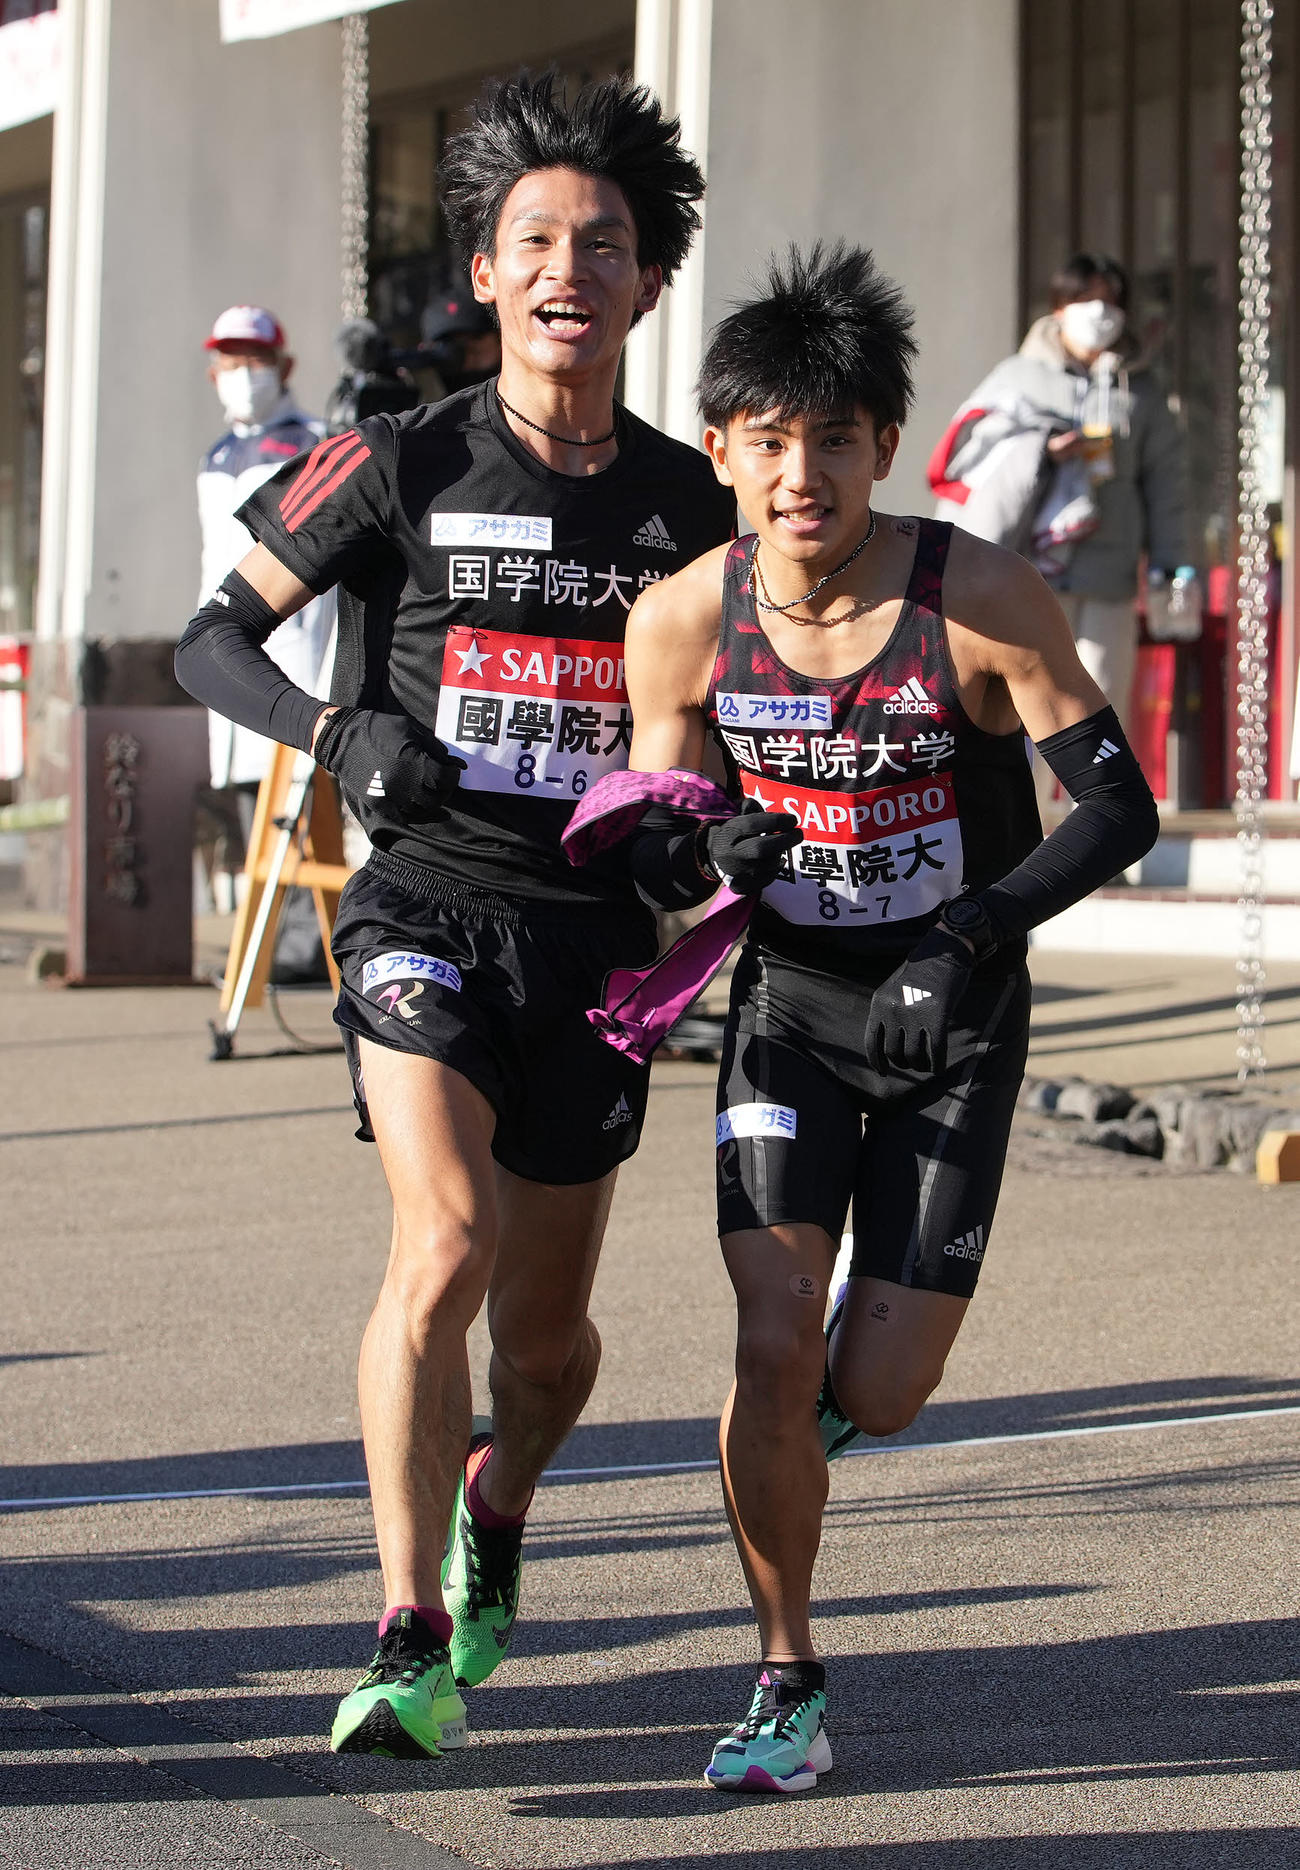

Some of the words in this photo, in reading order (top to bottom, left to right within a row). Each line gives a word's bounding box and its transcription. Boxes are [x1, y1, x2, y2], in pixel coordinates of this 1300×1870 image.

[468, 519, 549, 542] アサガミ
[632, 534, 678, 552] adidas
[748, 700, 829, 723] アサガミ
[882, 699, 938, 715] adidas
[455, 695, 634, 756] 國學院大
[720, 730, 956, 781] 国学院大学
[782, 787, 946, 834] SAPPORO
[387, 955, 461, 990] アサガミ
[943, 1244, 984, 1263] adida
